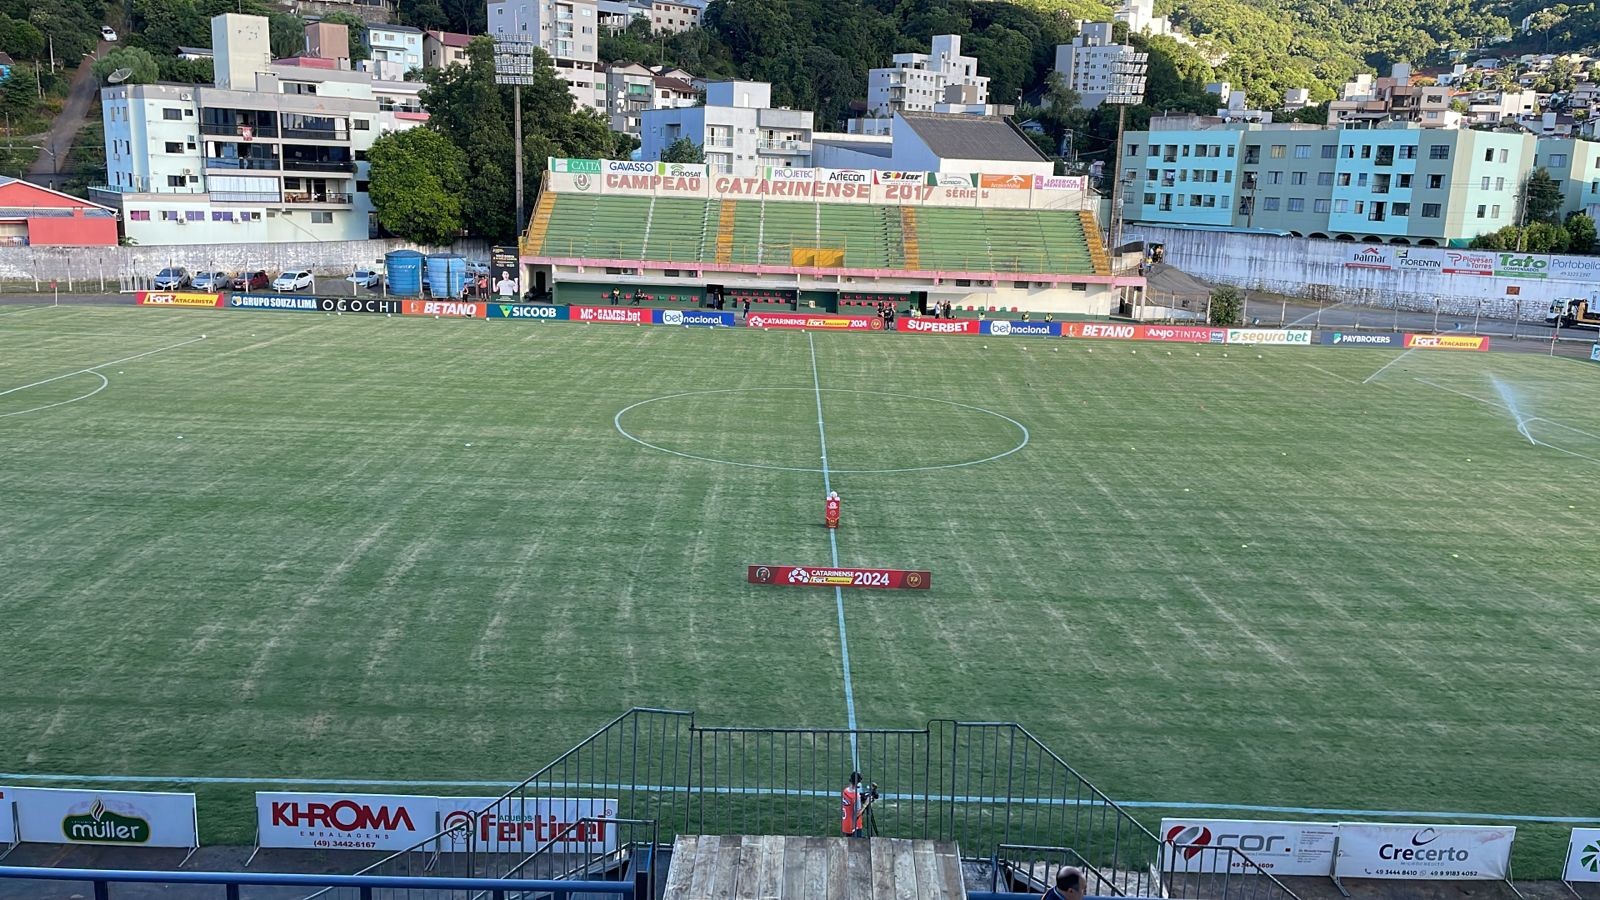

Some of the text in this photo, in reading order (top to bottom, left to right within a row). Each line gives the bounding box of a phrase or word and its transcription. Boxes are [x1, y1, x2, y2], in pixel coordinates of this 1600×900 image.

[609, 161, 654, 172] GAVASSO
[774, 168, 813, 178] PROJETEC
[715, 178, 871, 198] CATARINENSE
[885, 184, 935, 200] 2017
[1400, 259, 1440, 267] FIORENTIN
[1499, 254, 1547, 268] Tato
[149, 293, 174, 303] Fort
[242, 297, 317, 309] GRUPO SOUZA LIMA
[322, 299, 397, 313] OGOCHI
[424, 302, 477, 315] BETANO
[512, 307, 557, 317] SICOOB
[763, 317, 806, 326] CATARINENSE
[850, 319, 867, 327] 2024
[907, 319, 969, 332] SUPERBET
[1082, 325, 1135, 338] BETANO
[1175, 330, 1207, 339] TINTAS
[1241, 331, 1308, 343] segurobet
[1342, 335, 1391, 343] PAYBROKERS
[1415, 336, 1438, 346] Fort
[854, 572, 890, 586] 2024
[272, 800, 416, 832] KHROMA
[72, 821, 139, 839] müller
[300, 831, 389, 839] EMBALAGENS
[313, 840, 330, 848] (49)
[1379, 844, 1469, 862] Crecerto
